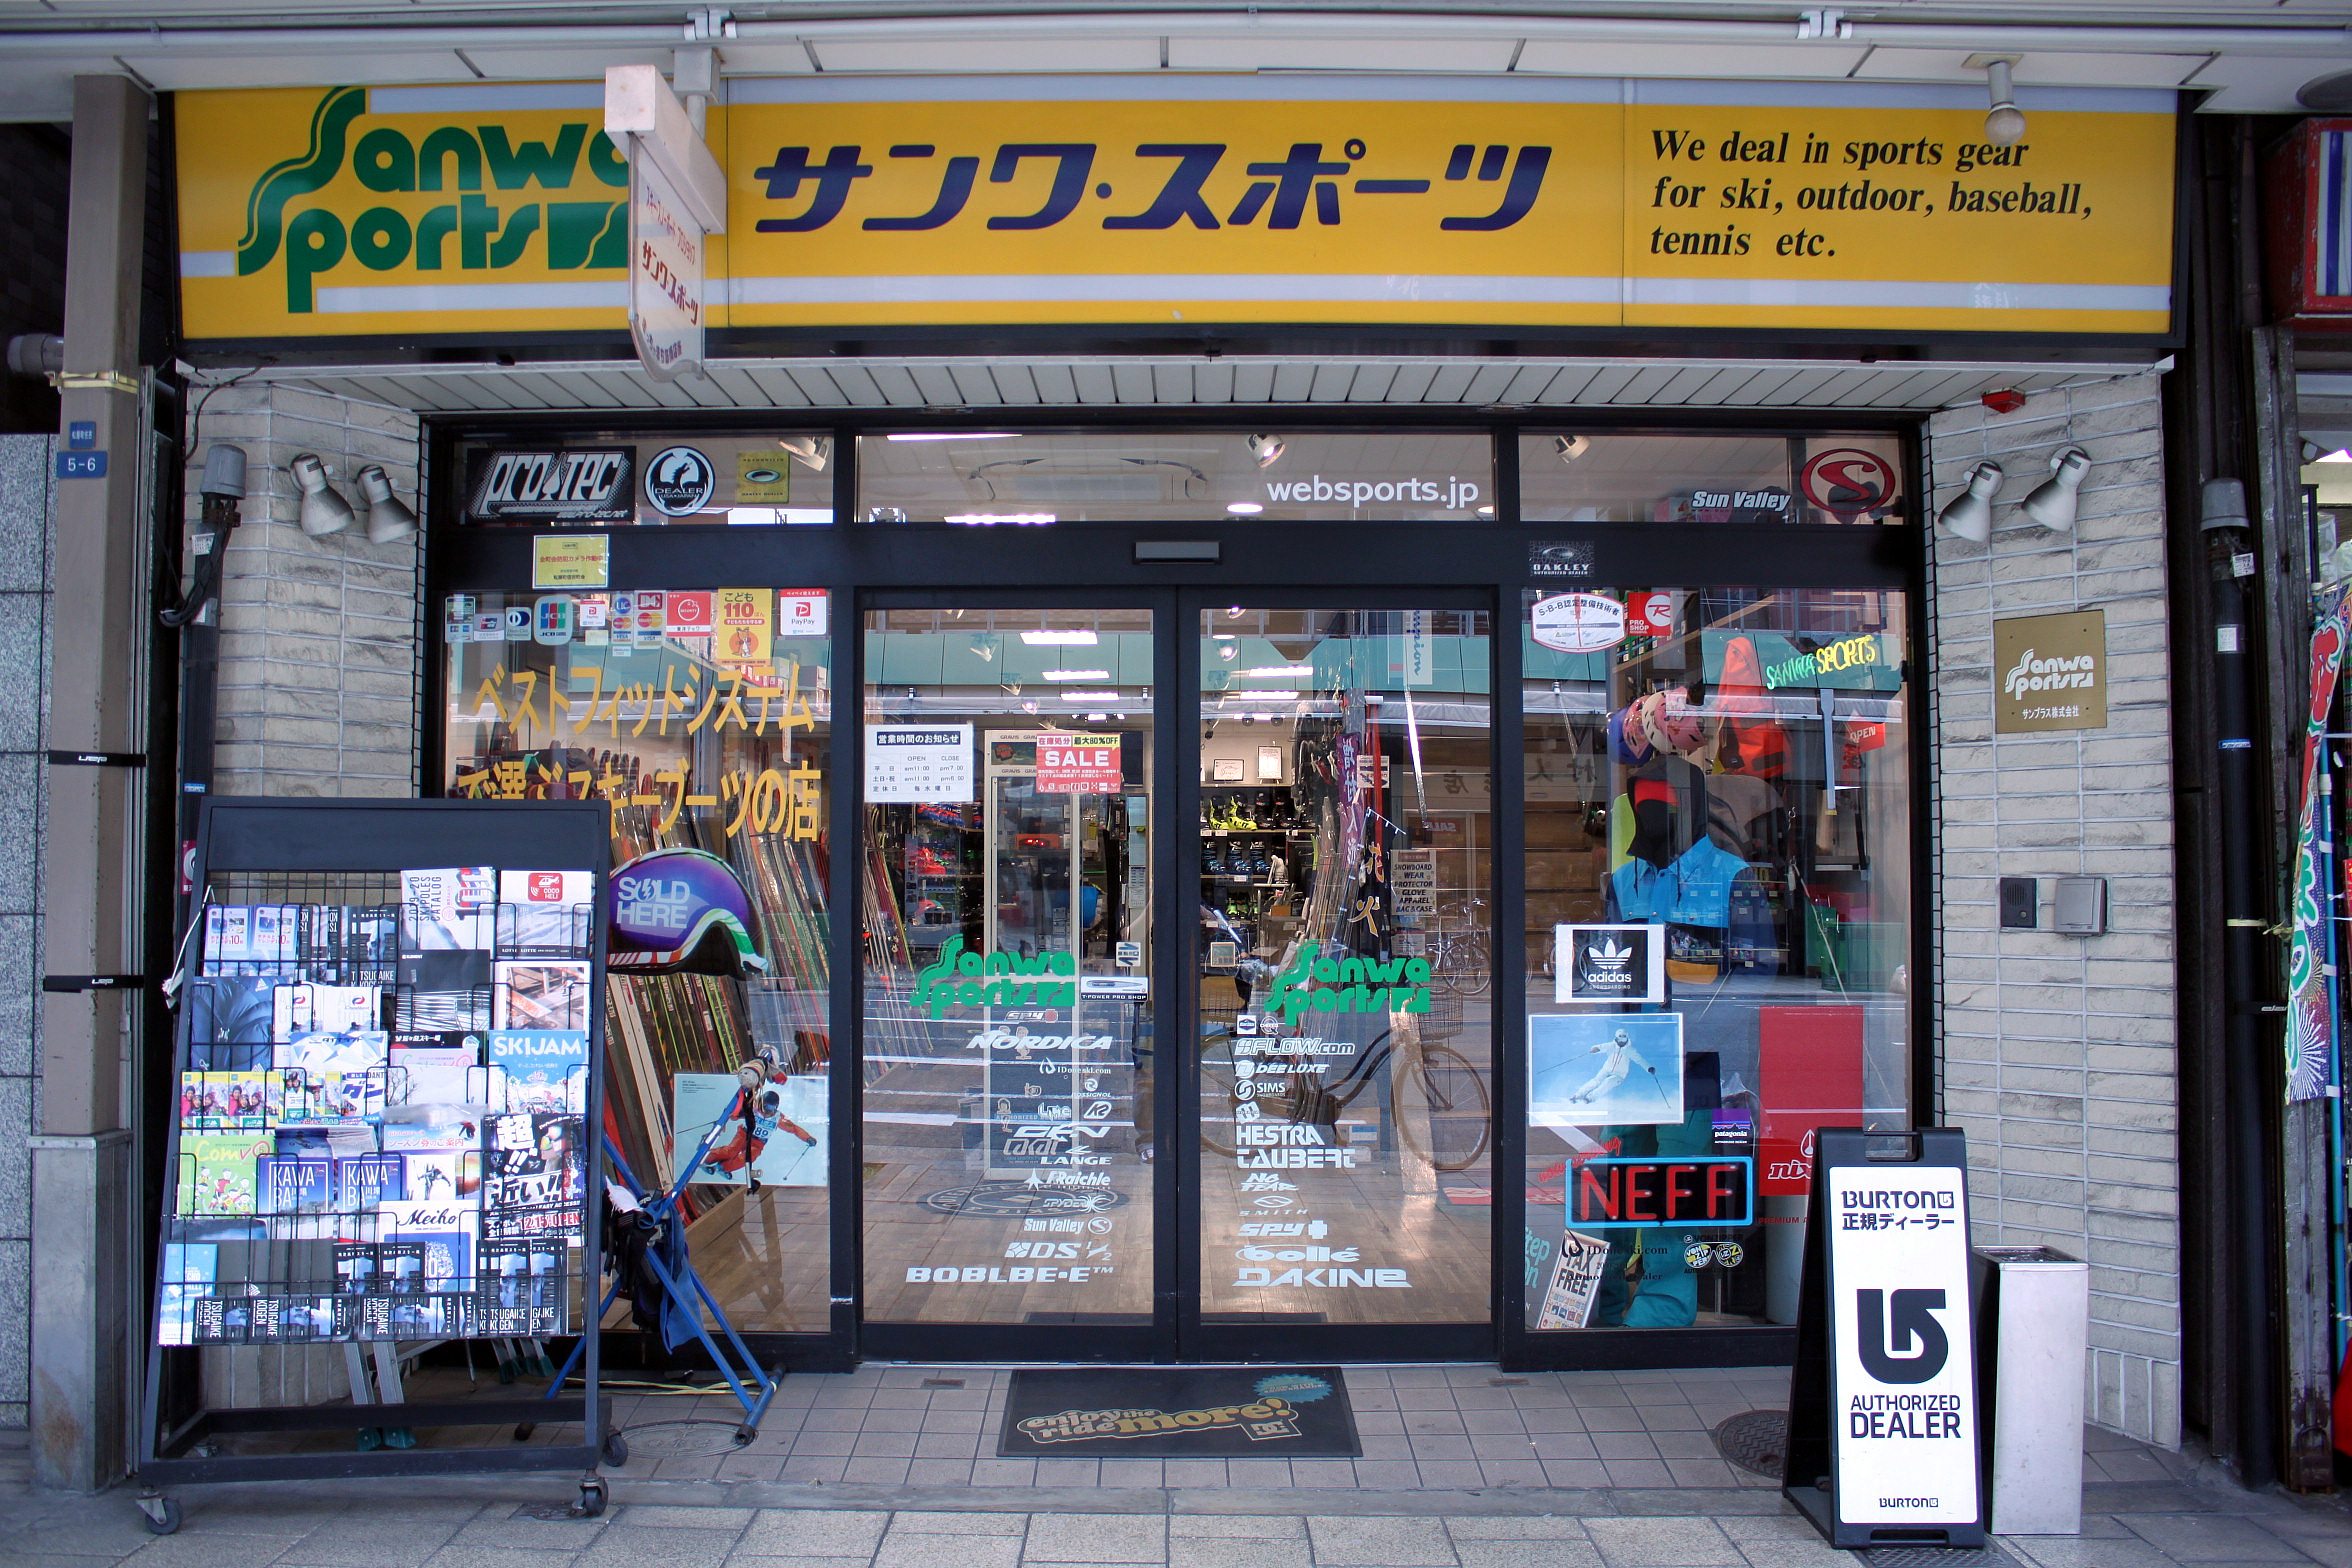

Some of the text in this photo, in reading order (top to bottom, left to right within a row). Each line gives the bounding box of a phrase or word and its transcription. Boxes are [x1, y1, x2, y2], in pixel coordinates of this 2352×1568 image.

[1652, 129, 2030, 171] We deal in sports gear
[754, 139, 1552, 233] サンワ・スポーツ
[1652, 177, 2092, 222] for ski, outdoor, baseball,
[1650, 224, 1837, 258] tennis etc.
[67, 457, 96, 472] 5-6
[1266, 475, 1479, 509] websports.jp
[1691, 491, 1792, 512] Sun Valley
[1533, 563, 1590, 571] OAKLEY
[724, 592, 754, 602] こども
[723, 602, 754, 617] 110
[2022, 704, 2079, 719] サンプラス株式会社
[877, 734, 959, 744] 営業時間のお知らせ
[1850, 725, 1876, 744] OPEN
[1044, 750, 1110, 767] SALE
[1393, 863, 1433, 871] SNOWBOARD
[431, 876, 442, 922] CATALOG
[617, 876, 691, 904] SOLD
[615, 901, 689, 929] HERE
[1587, 971, 1632, 983] adidas
[493, 1036, 582, 1056] SKIJAM
[966, 1029, 1114, 1050] NORDICA
[1257, 1082, 1286, 1093] SIMS
[1236, 1125, 1325, 1146] HESTRA
[1040, 1157, 1113, 1165] LANGE
[1767, 1160, 1812, 1180] nix
[273, 1187, 292, 1207] BA
[347, 1187, 366, 1207] BA
[1580, 1165, 1739, 1222] NEFF
[1842, 1190, 1936, 1209] BURTON
[1239, 1208, 1309, 1217] SMITH
[1842, 1212, 1955, 1231] 正規ディーラー
[1024, 1219, 1085, 1234] Sun Valley
[1237, 1222, 1305, 1237] SPY
[1525, 1226, 1551, 1264] tep
[1555, 1267, 1590, 1297] FREE
[256, 1299, 268, 1325] KOGEN
[267, 1299, 280, 1337] TSUGAIKE
[532, 1307, 555, 1319] GAIKE
[1850, 1394, 1961, 1412] AUTHORIZED
[1026, 1409, 1122, 1429] enjoy
[1113, 1398, 1292, 1434] more!
[1122, 1409, 1157, 1418] the
[1039, 1421, 1115, 1438] ride
[1850, 1411, 1962, 1440] DEALER
[1879, 1497, 1930, 1508] BURTON
